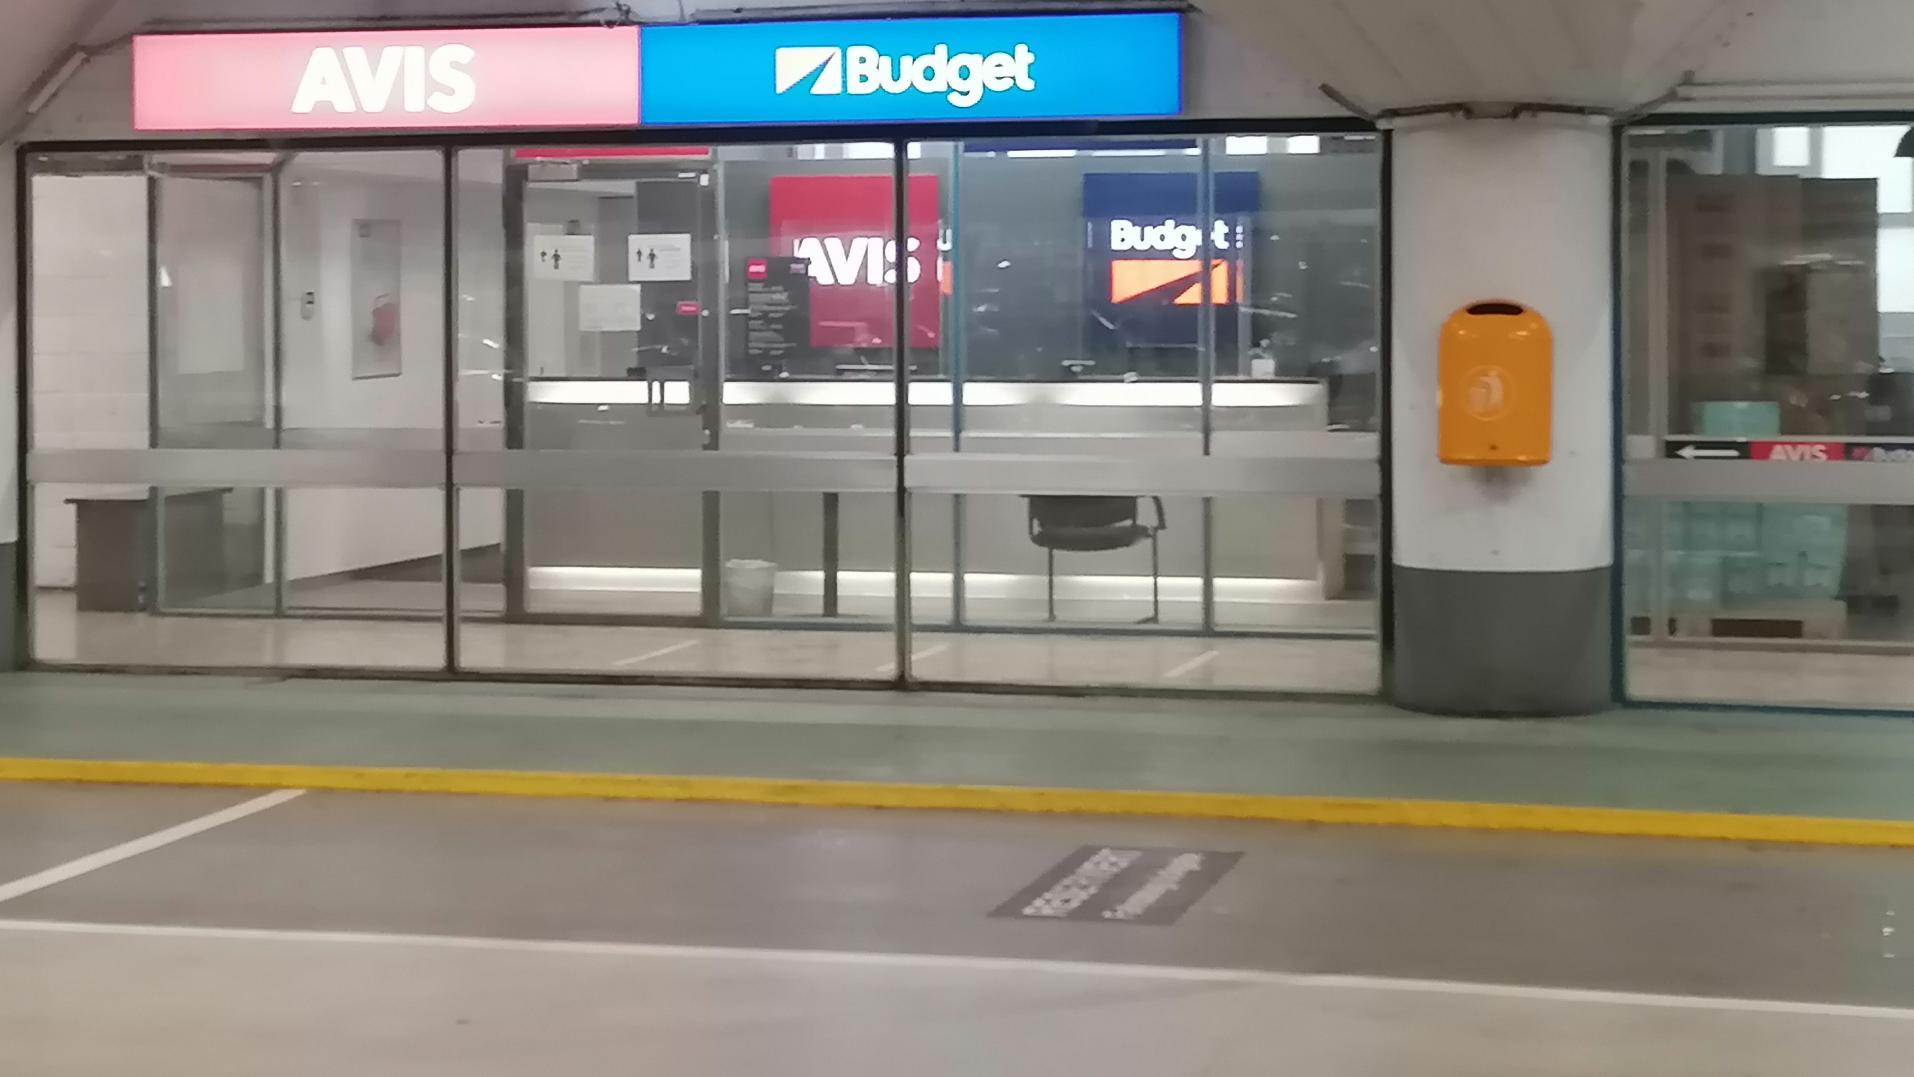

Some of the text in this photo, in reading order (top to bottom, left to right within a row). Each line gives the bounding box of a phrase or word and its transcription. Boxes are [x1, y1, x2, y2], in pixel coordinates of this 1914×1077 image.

[291, 43, 476, 113] AVIS
[846, 43, 1036, 108] Budget
[1769, 444, 1829, 461] AVIS
